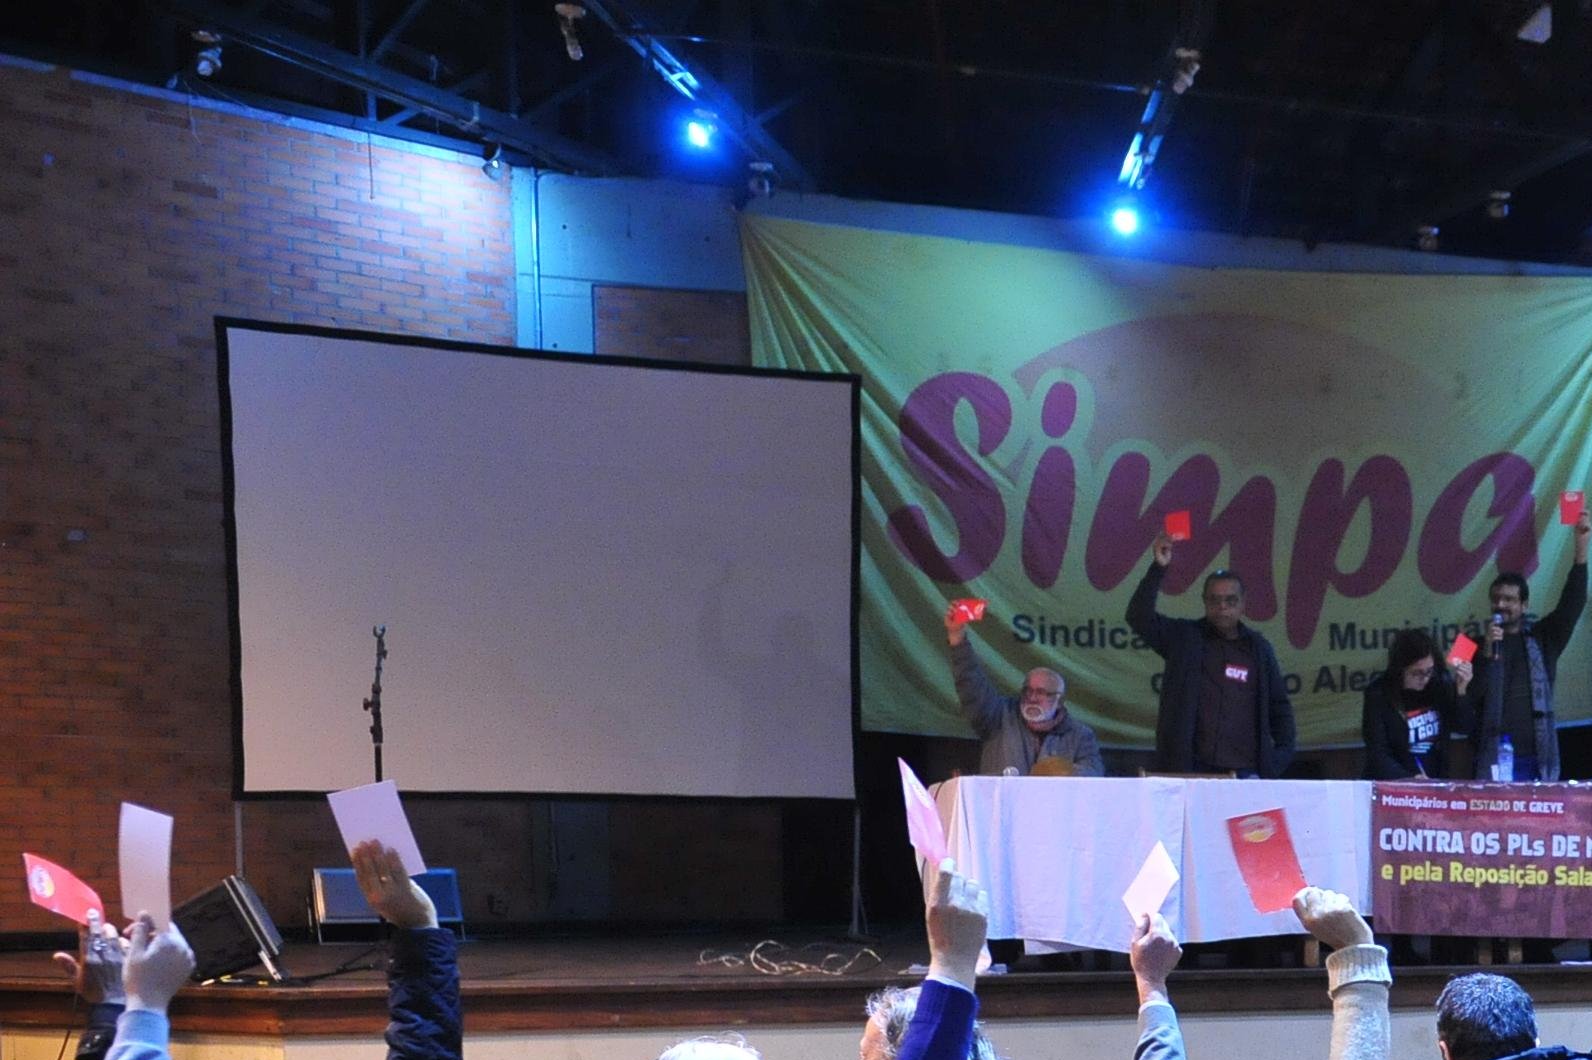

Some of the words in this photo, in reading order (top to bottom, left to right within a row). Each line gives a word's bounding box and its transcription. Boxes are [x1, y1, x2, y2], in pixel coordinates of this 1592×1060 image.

[887, 372, 1540, 650] Simpa
[1012, 614, 1152, 650] Sindica
[1382, 795, 1448, 810] Municipários
[1450, 800, 1467, 810] em
[1469, 799, 1510, 812] ESTADO
[1512, 801, 1527, 812] DE
[1529, 802, 1564, 814] GREVE
[1379, 828, 1465, 854] CONTRA
[1471, 832, 1501, 855] OS
[1507, 833, 1545, 857] PLs
[1552, 834, 1581, 858] DE
[1381, 864, 1393, 880] e
[1400, 861, 1443, 885] pela
[1450, 861, 1548, 888] Reposição
